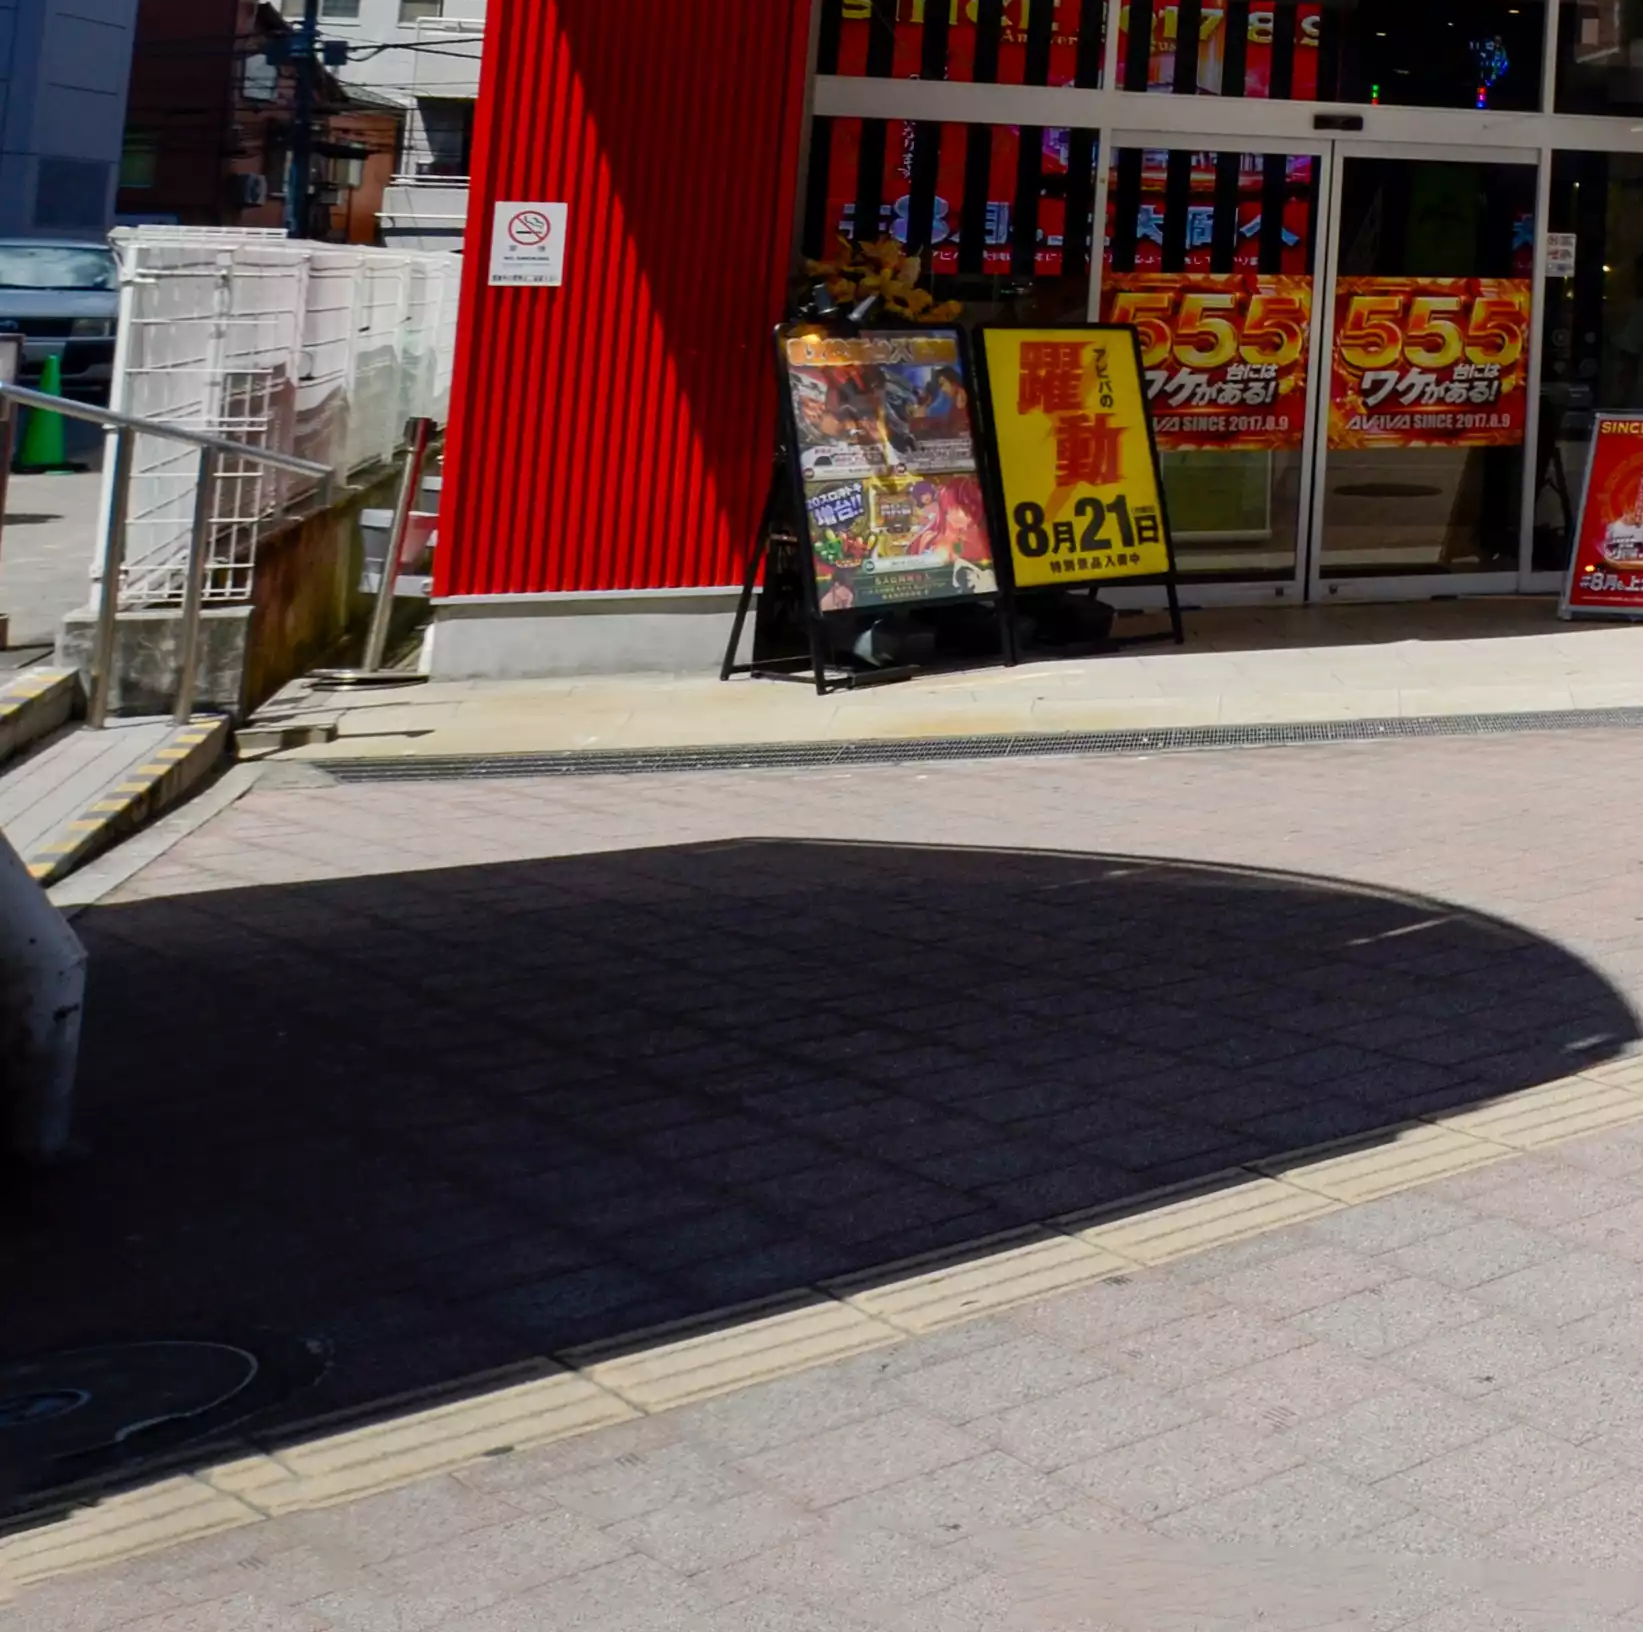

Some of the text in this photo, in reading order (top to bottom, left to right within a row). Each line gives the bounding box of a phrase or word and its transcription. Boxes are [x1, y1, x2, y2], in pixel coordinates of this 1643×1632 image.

[1110, 291, 1304, 369] 555
[1339, 295, 1524, 369] 555
[1360, 368, 1498, 407] ワケがある!
[1182, 414, 1227, 432] SINCE
[1413, 411, 1454, 430] SINCE
[1012, 493, 1161, 558] 8月21日
